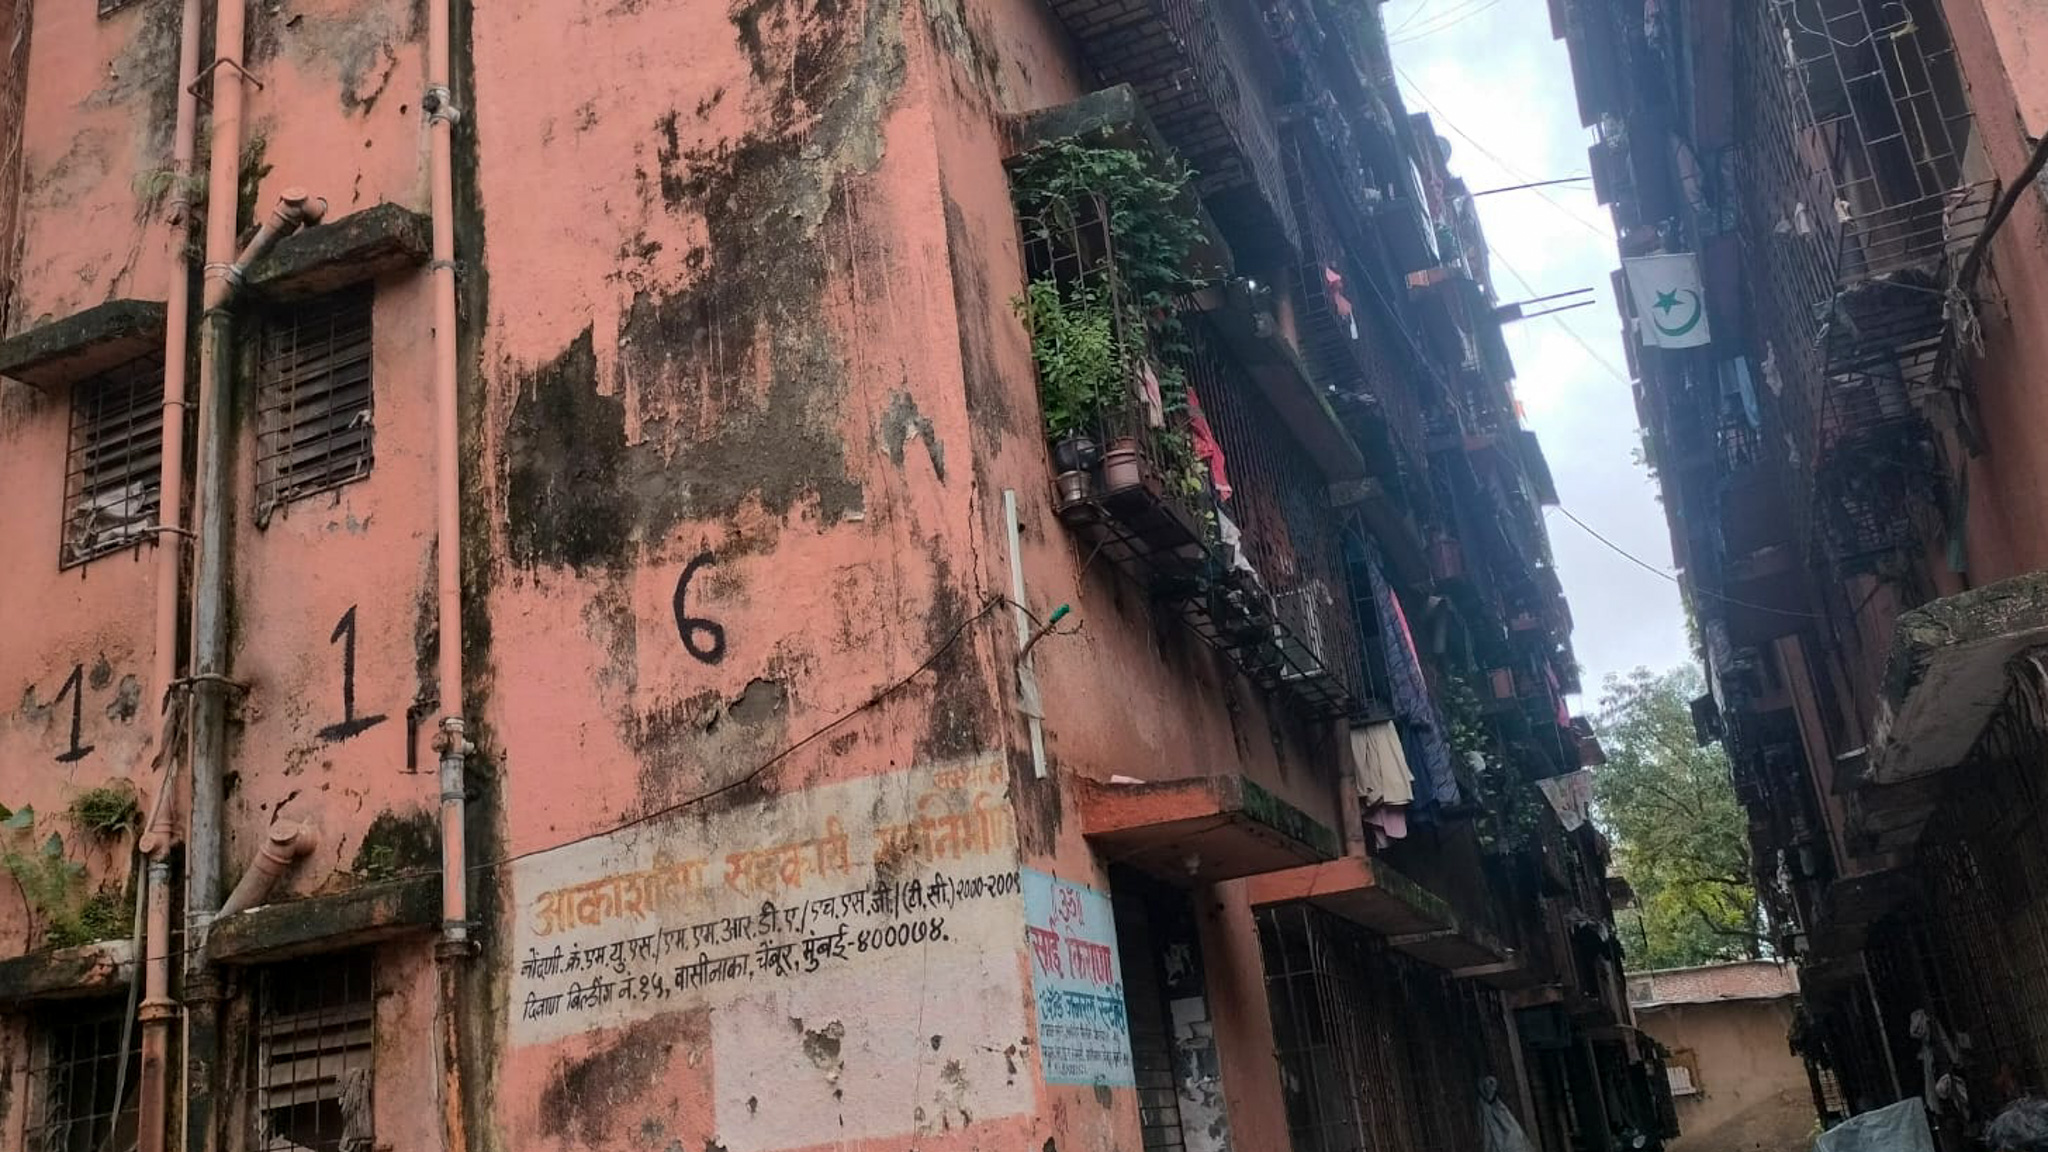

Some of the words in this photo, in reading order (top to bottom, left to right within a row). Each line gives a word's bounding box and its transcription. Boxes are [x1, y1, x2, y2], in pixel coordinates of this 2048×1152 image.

[673, 550, 727, 666] 6
[54, 663, 96, 763] 1
[313, 603, 390, 744] 1
